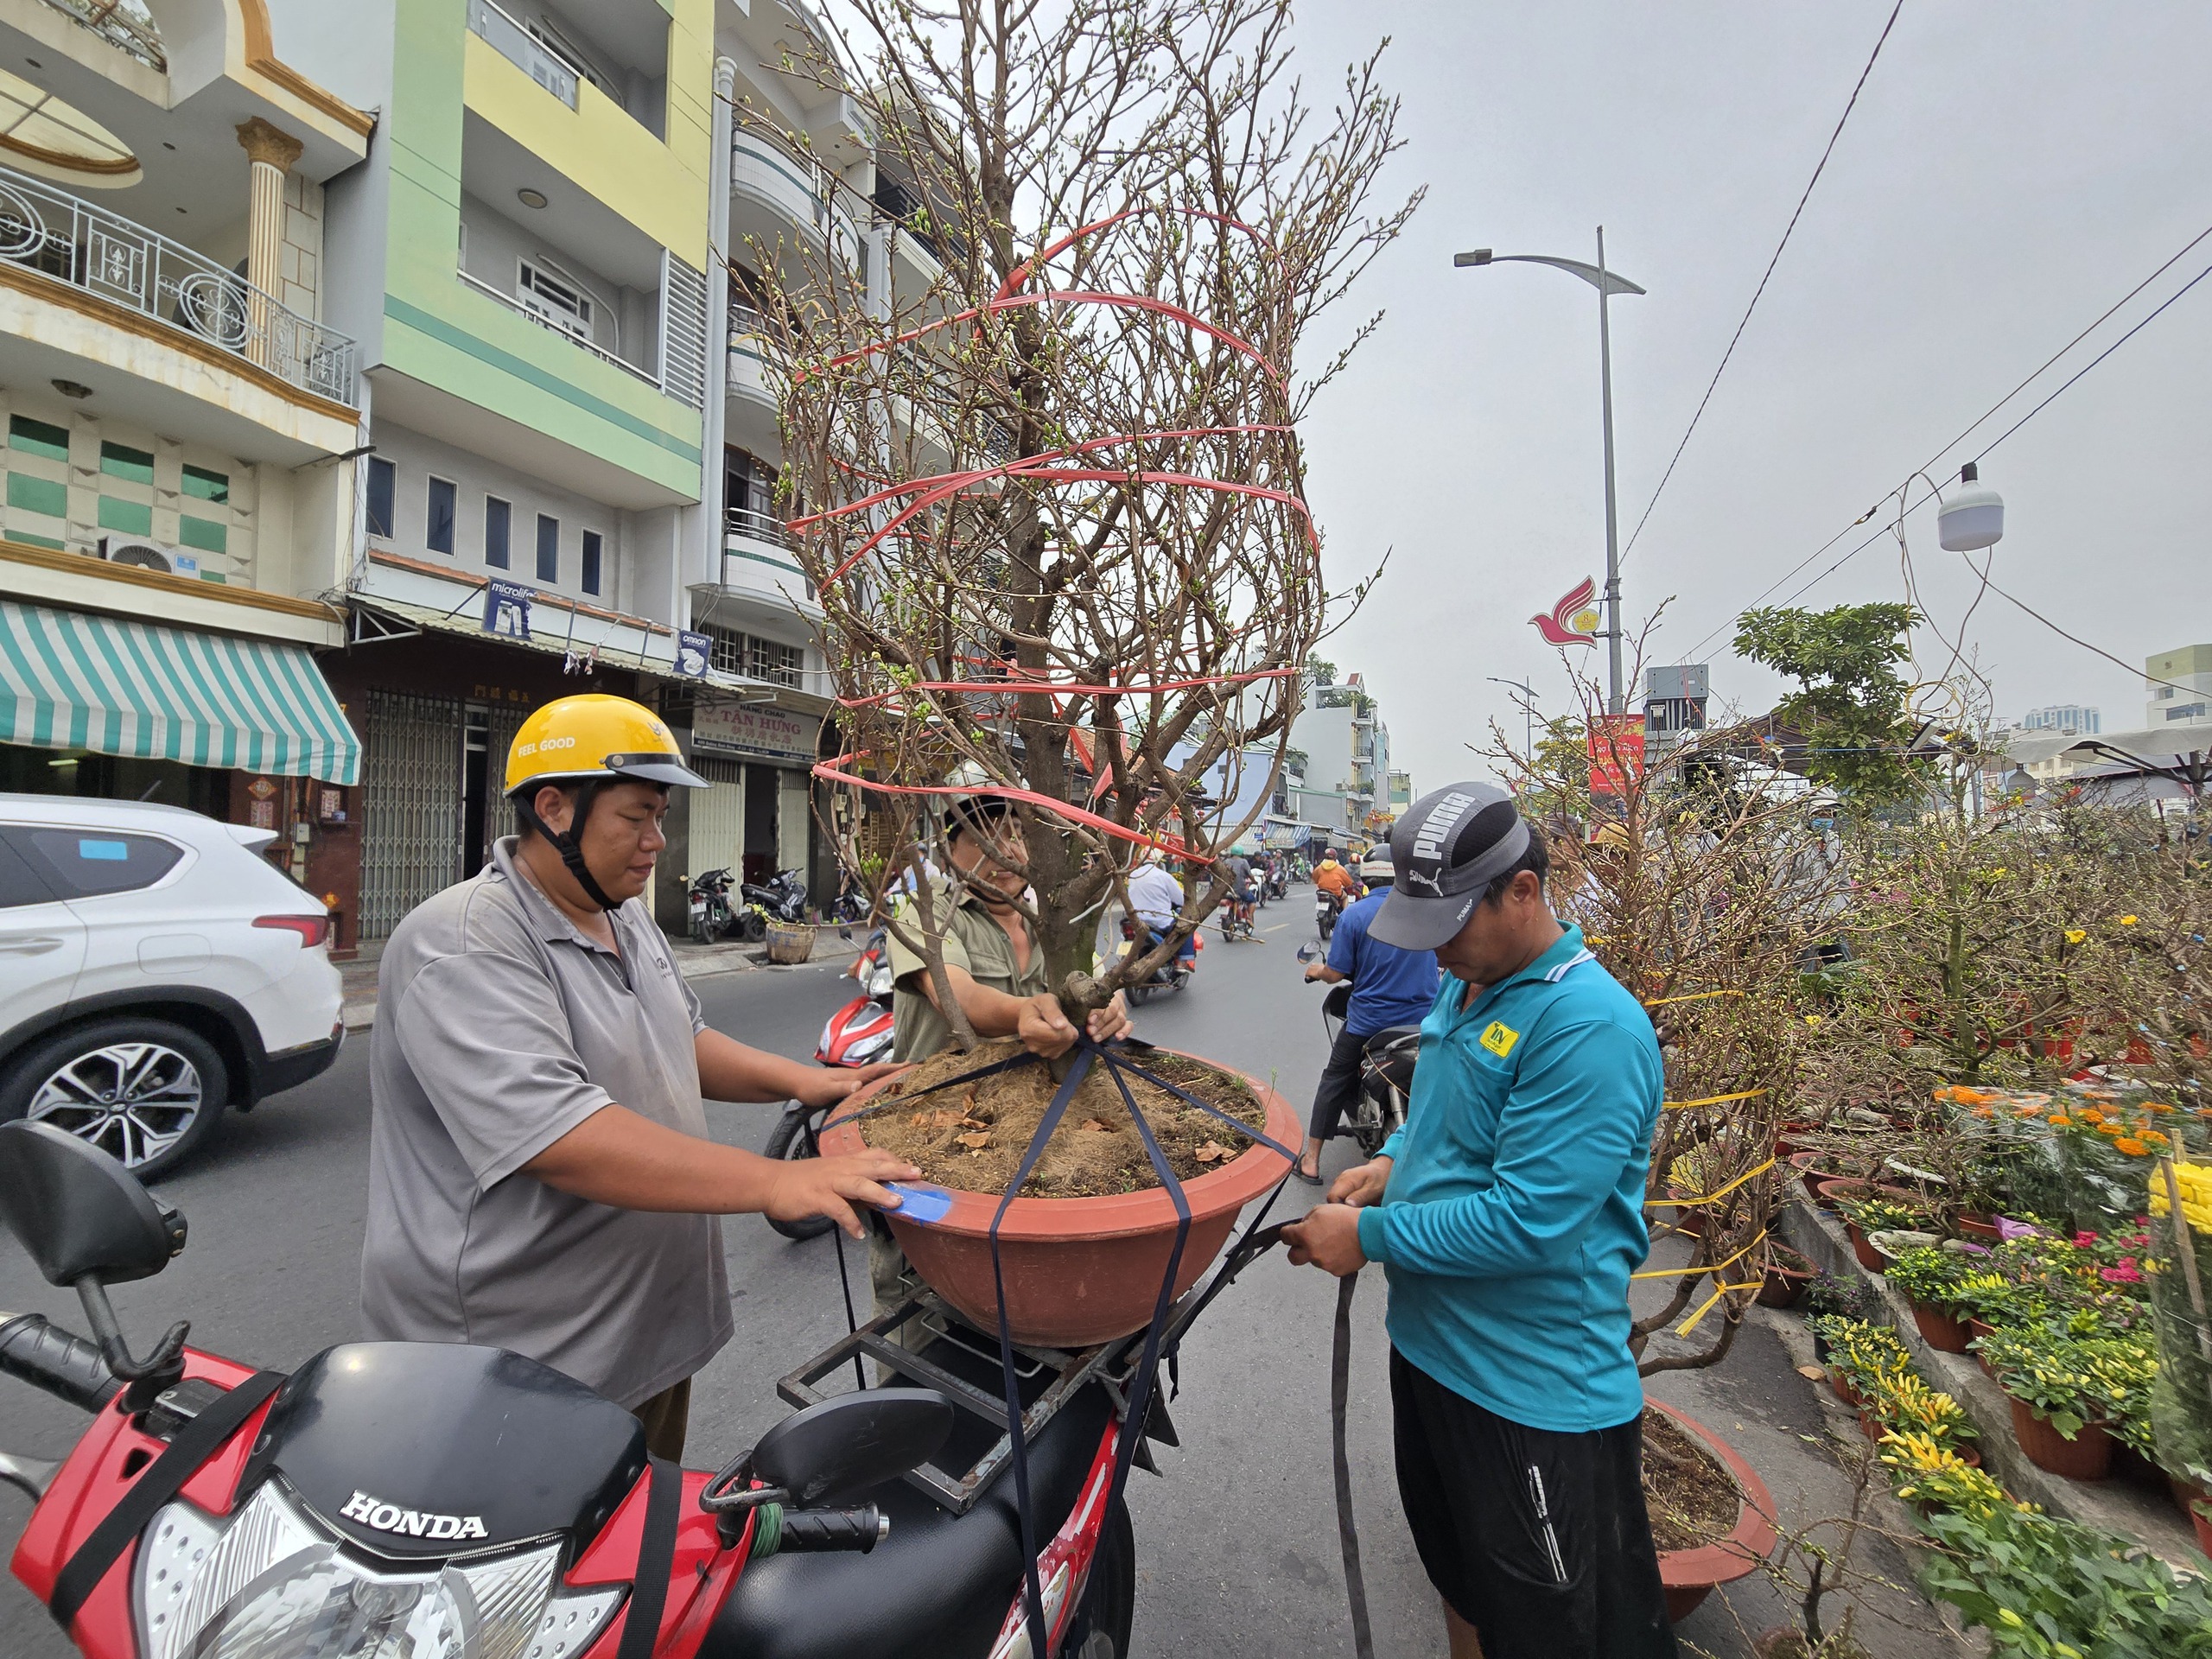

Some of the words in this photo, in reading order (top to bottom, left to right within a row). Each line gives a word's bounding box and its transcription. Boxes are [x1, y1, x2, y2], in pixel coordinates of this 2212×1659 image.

[720, 709, 754, 728] TÂN
[759, 716, 802, 735] HƯNG
[518, 744, 537, 758] FEEL
[539, 737, 575, 751] GOOD
[1413, 792, 1476, 861] PUMA
[1456, 904, 1471, 922] PUMA
[340, 1491, 489, 1539] HONDA
